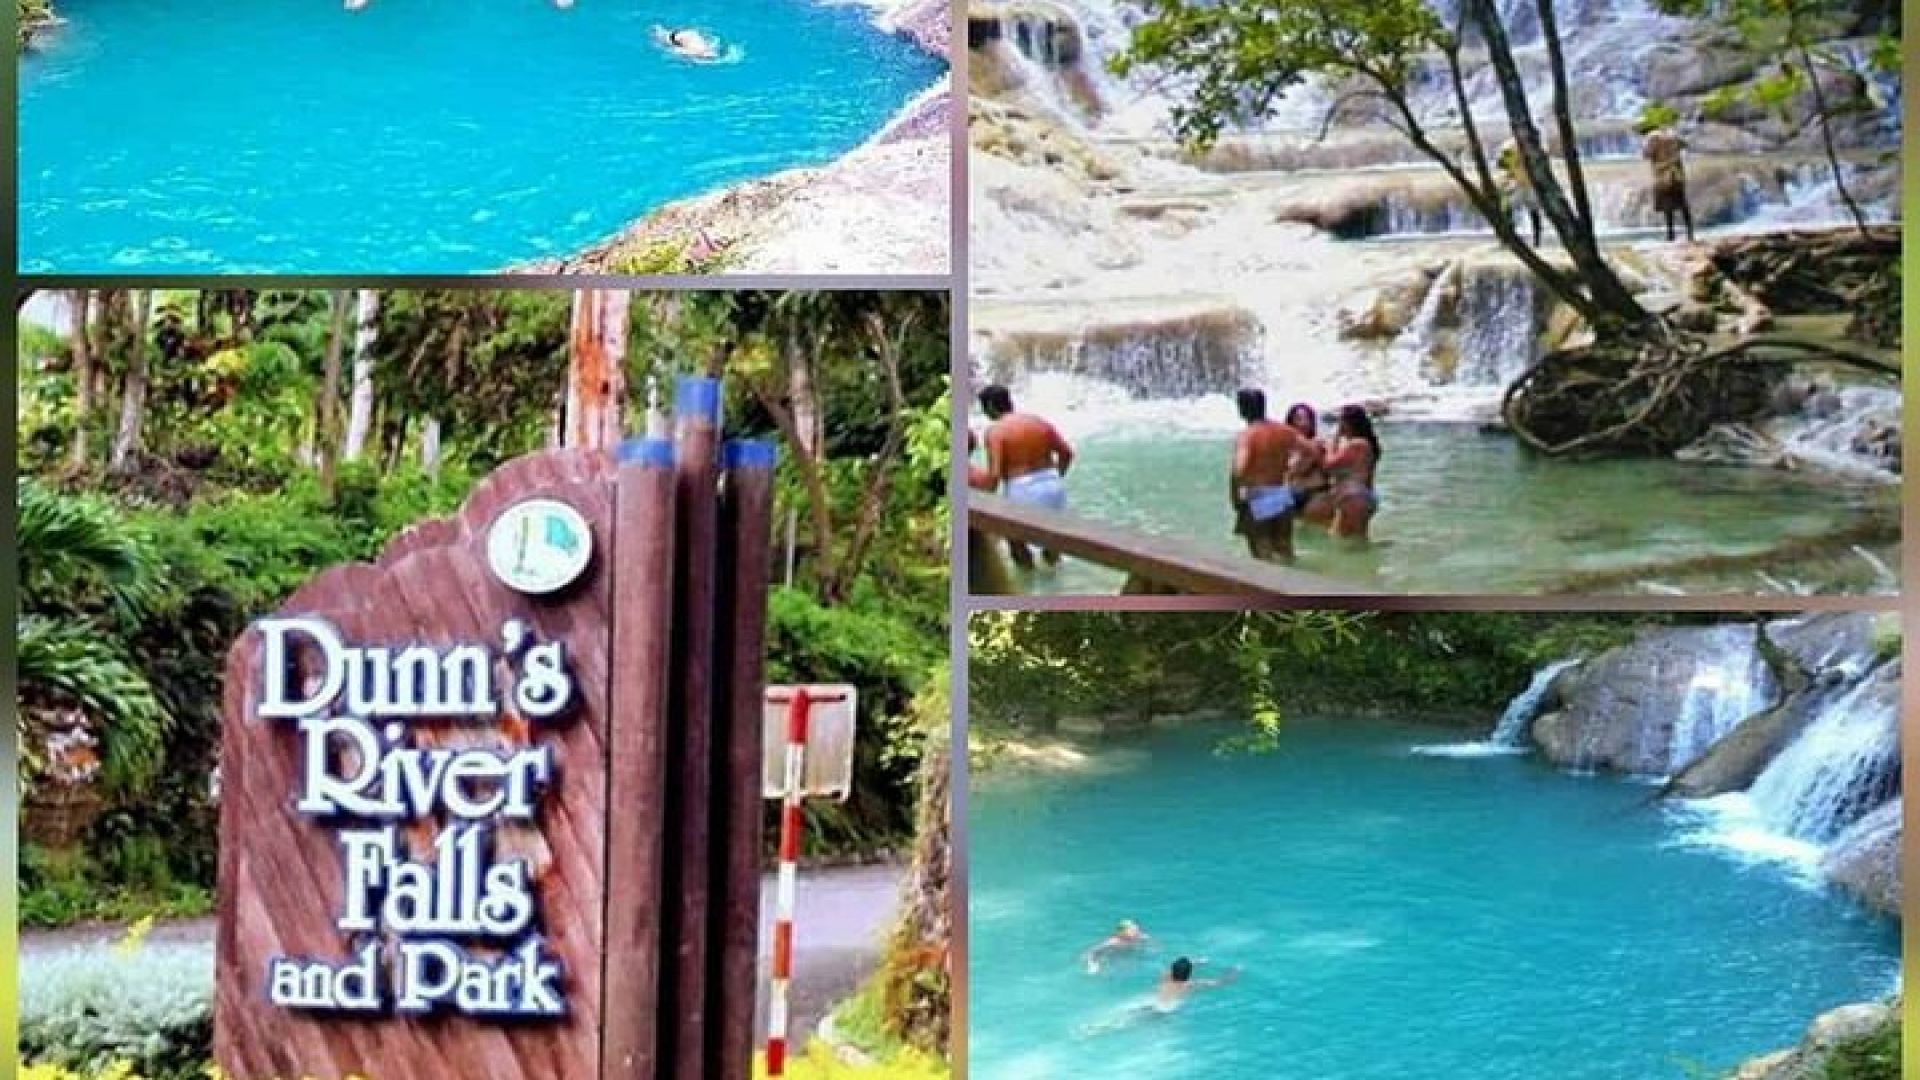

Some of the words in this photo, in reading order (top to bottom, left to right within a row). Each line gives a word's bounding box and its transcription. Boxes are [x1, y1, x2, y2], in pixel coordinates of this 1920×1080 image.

[256, 618, 571, 717] Dunn's
[298, 718, 552, 818] River
[338, 825, 535, 934] Falls
[271, 946, 384, 1009] and
[396, 943, 563, 1011] Park
